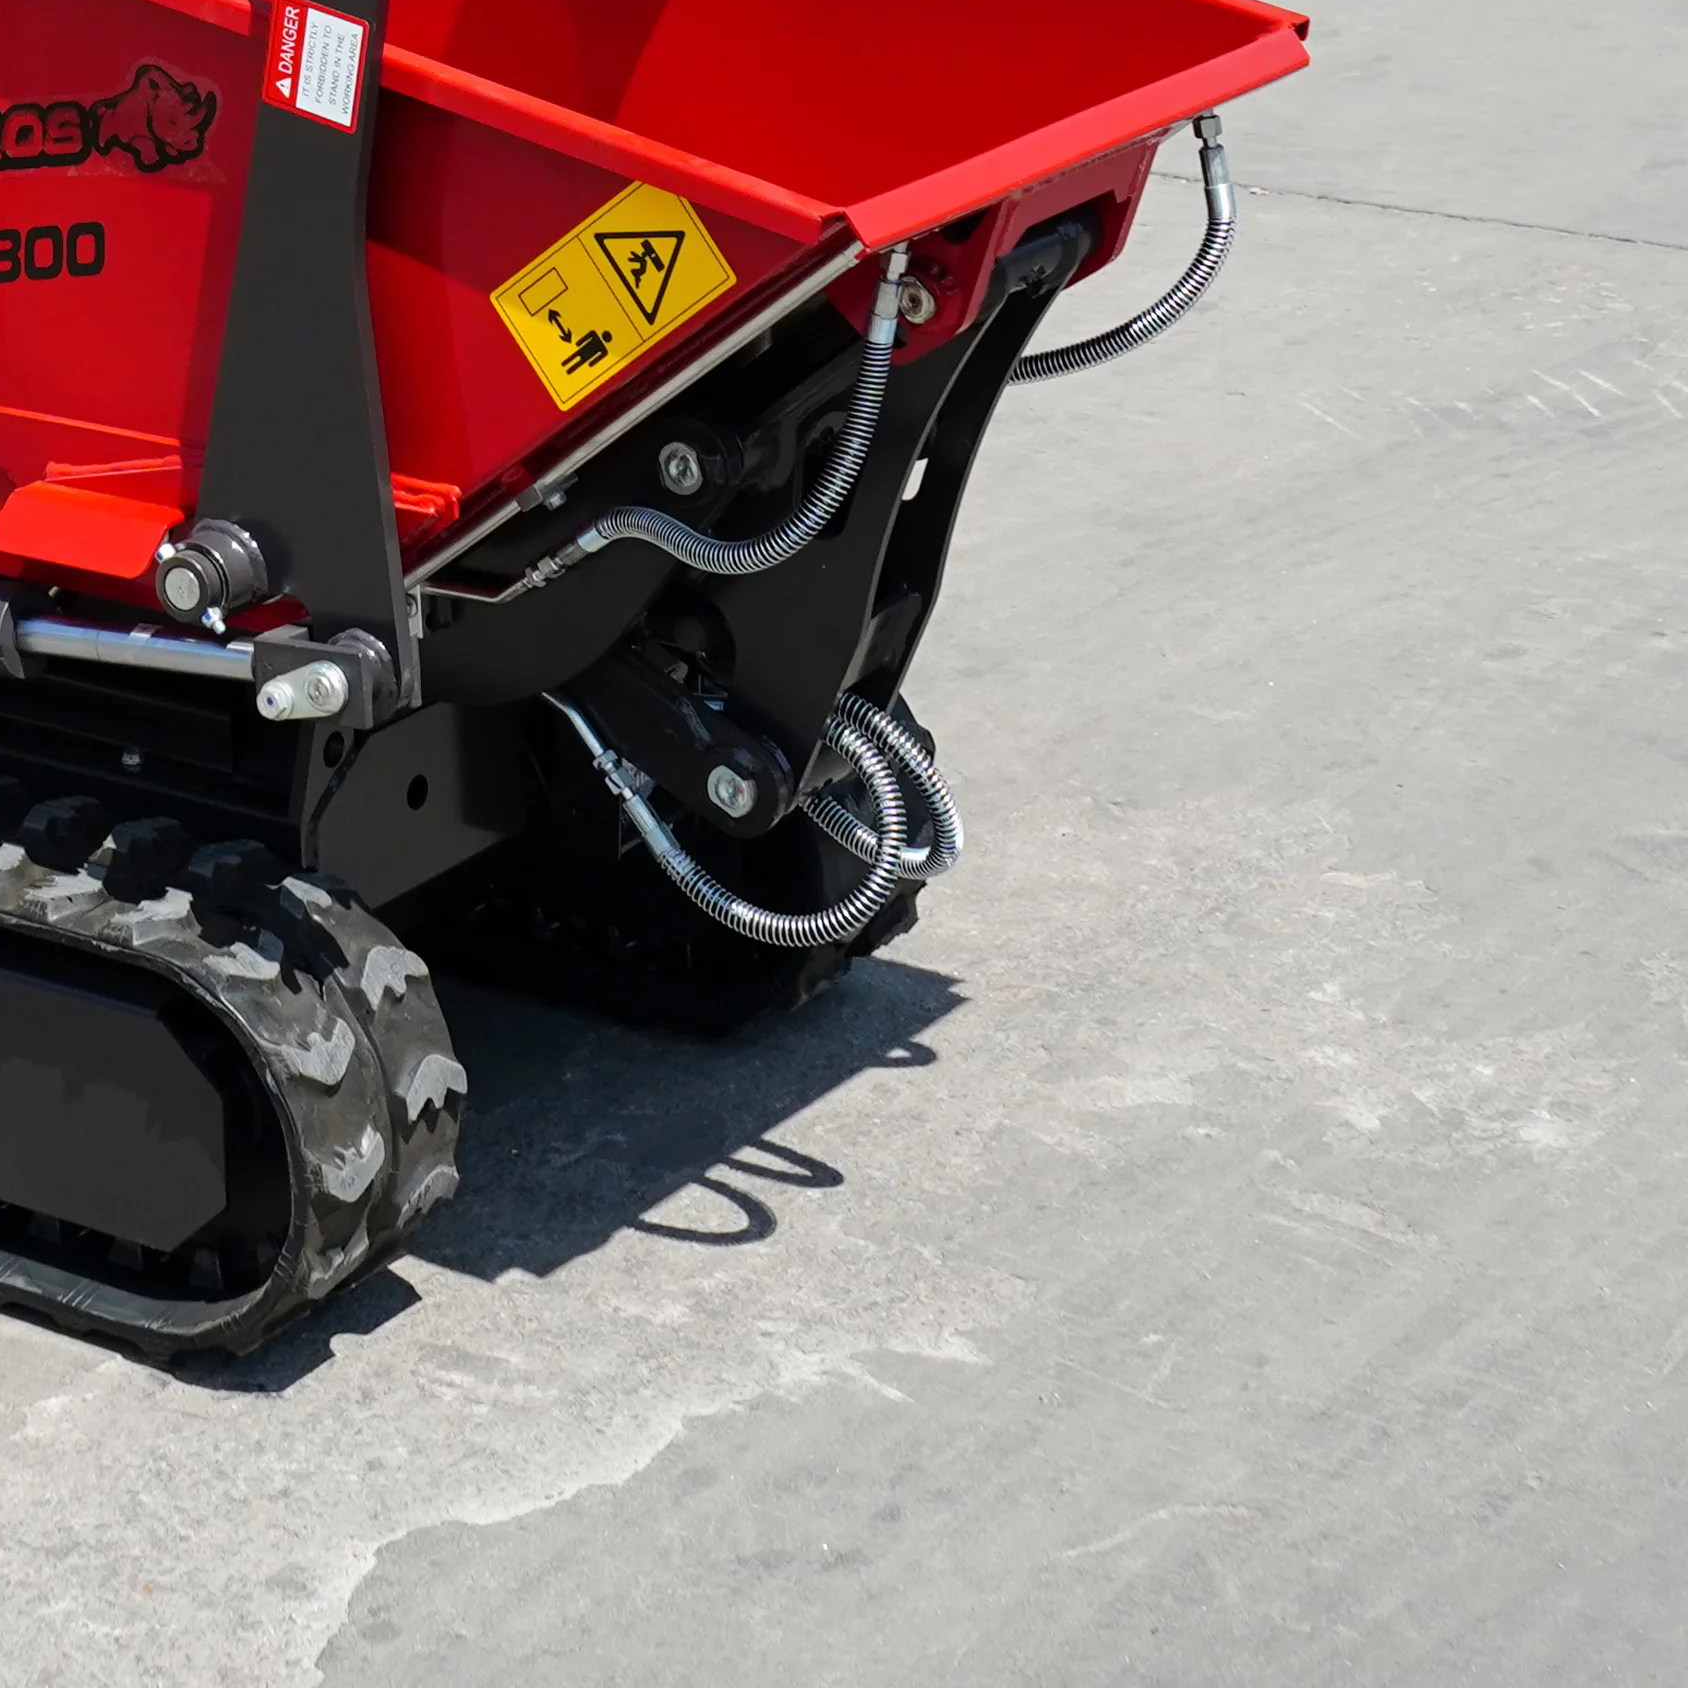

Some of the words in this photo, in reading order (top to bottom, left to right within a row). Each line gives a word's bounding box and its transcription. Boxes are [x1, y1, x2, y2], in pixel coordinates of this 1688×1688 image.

[278, 6, 301, 74] DANGER
[305, 21, 319, 73] STRICTLY
[335, 33, 346, 55] THE
[348, 33, 359, 63] AREA
[314, 42, 330, 104] FORBIDDEN
[323, 25, 332, 38] TO
[334, 57, 342, 68] IN
[302, 87, 309, 98] IT
[304, 75, 312, 86] IS
[328, 71, 341, 105] STAND
[341, 64, 356, 115] WORKING
